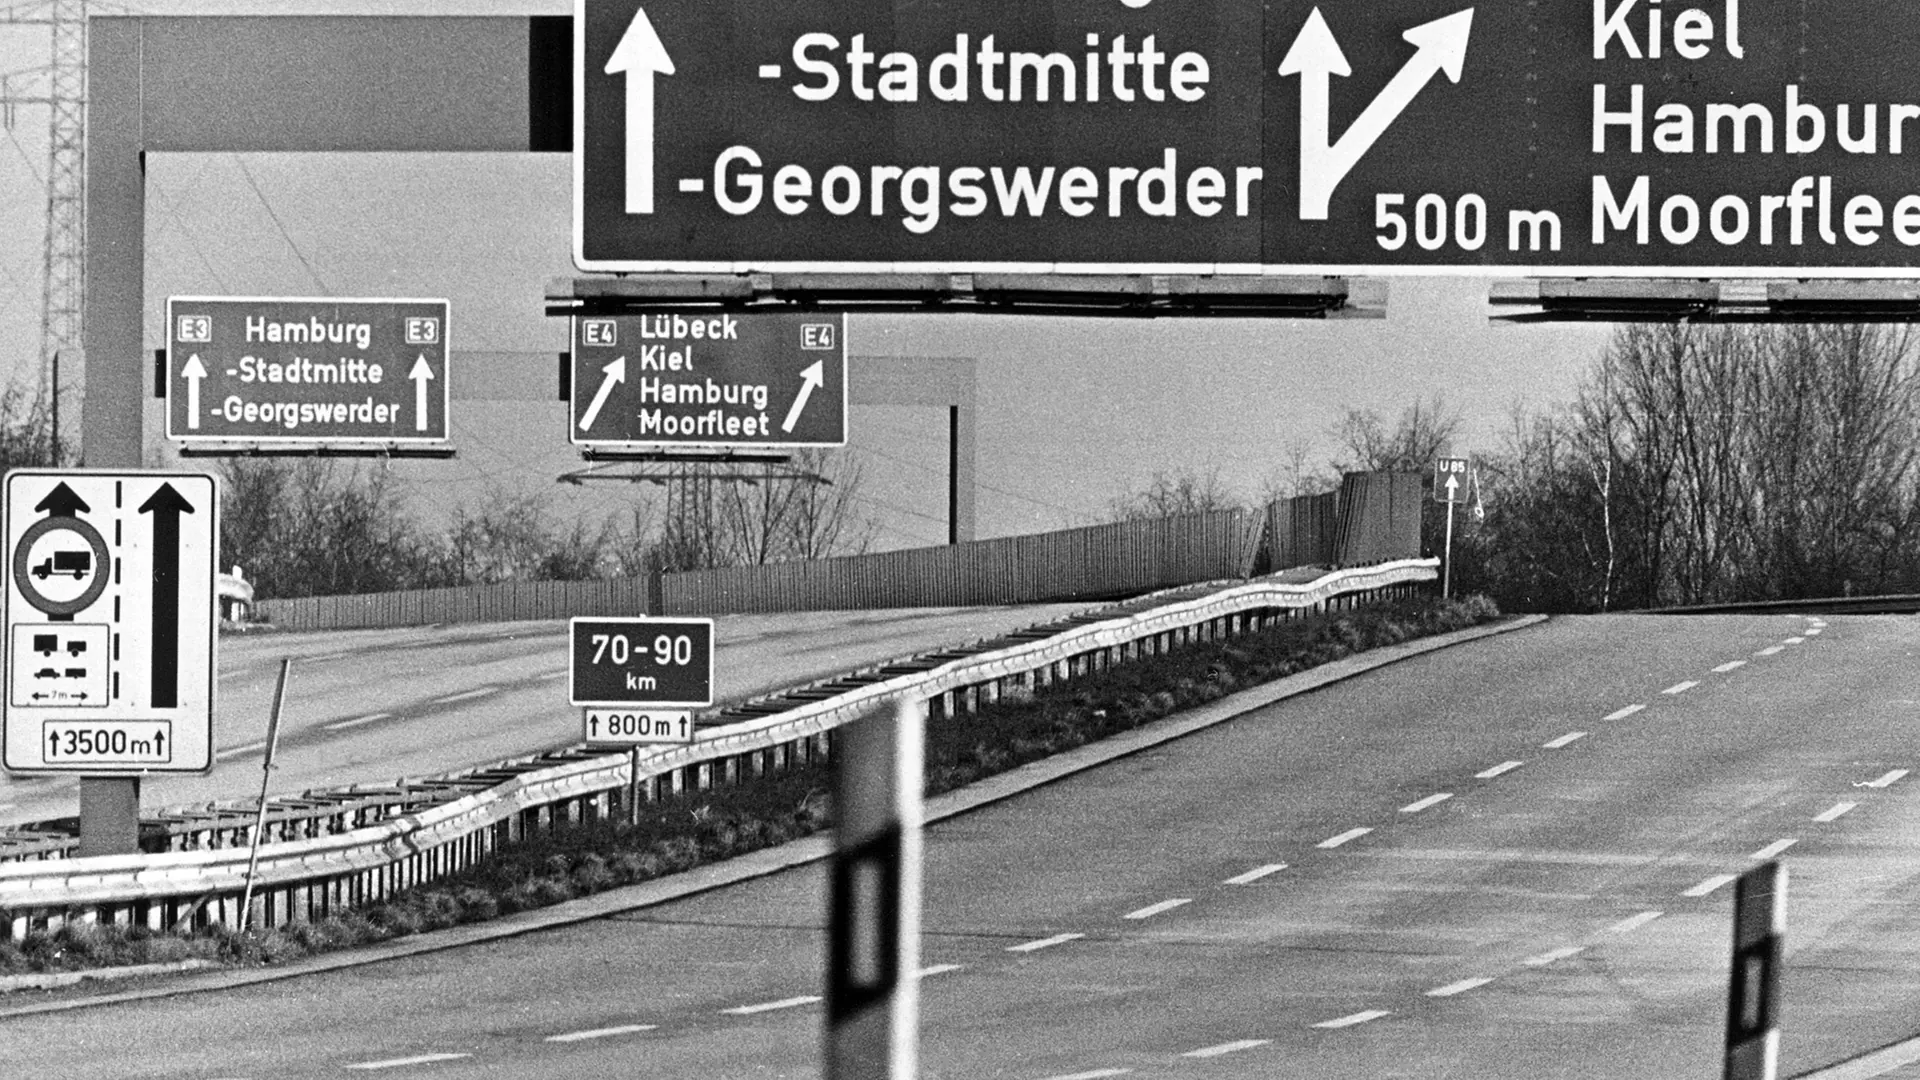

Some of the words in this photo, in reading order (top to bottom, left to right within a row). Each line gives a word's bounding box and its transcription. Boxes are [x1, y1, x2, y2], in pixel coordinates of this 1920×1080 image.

[1593, 0, 1744, 60] Kiel
[758, 32, 1210, 102] -Stadtmitte
[1592, 83, 1920, 154] Hambur
[678, 145, 1263, 234] -Georgswerder
[1375, 193, 1487, 251] 500
[1508, 209, 1562, 251] m
[181, 318, 208, 339] E3
[245, 315, 371, 349] Hamburg
[409, 320, 435, 340] E3
[586, 323, 613, 344] E4
[640, 313, 738, 340] Lübeck
[804, 326, 831, 346] E4
[225, 355, 384, 384] -Stadtmitte
[640, 344, 694, 371] Kiel
[640, 376, 768, 410] Hamburg
[210, 394, 401, 429] -Georgswerder
[640, 408, 770, 436] Moorfleet
[626, 671, 657, 691] km
